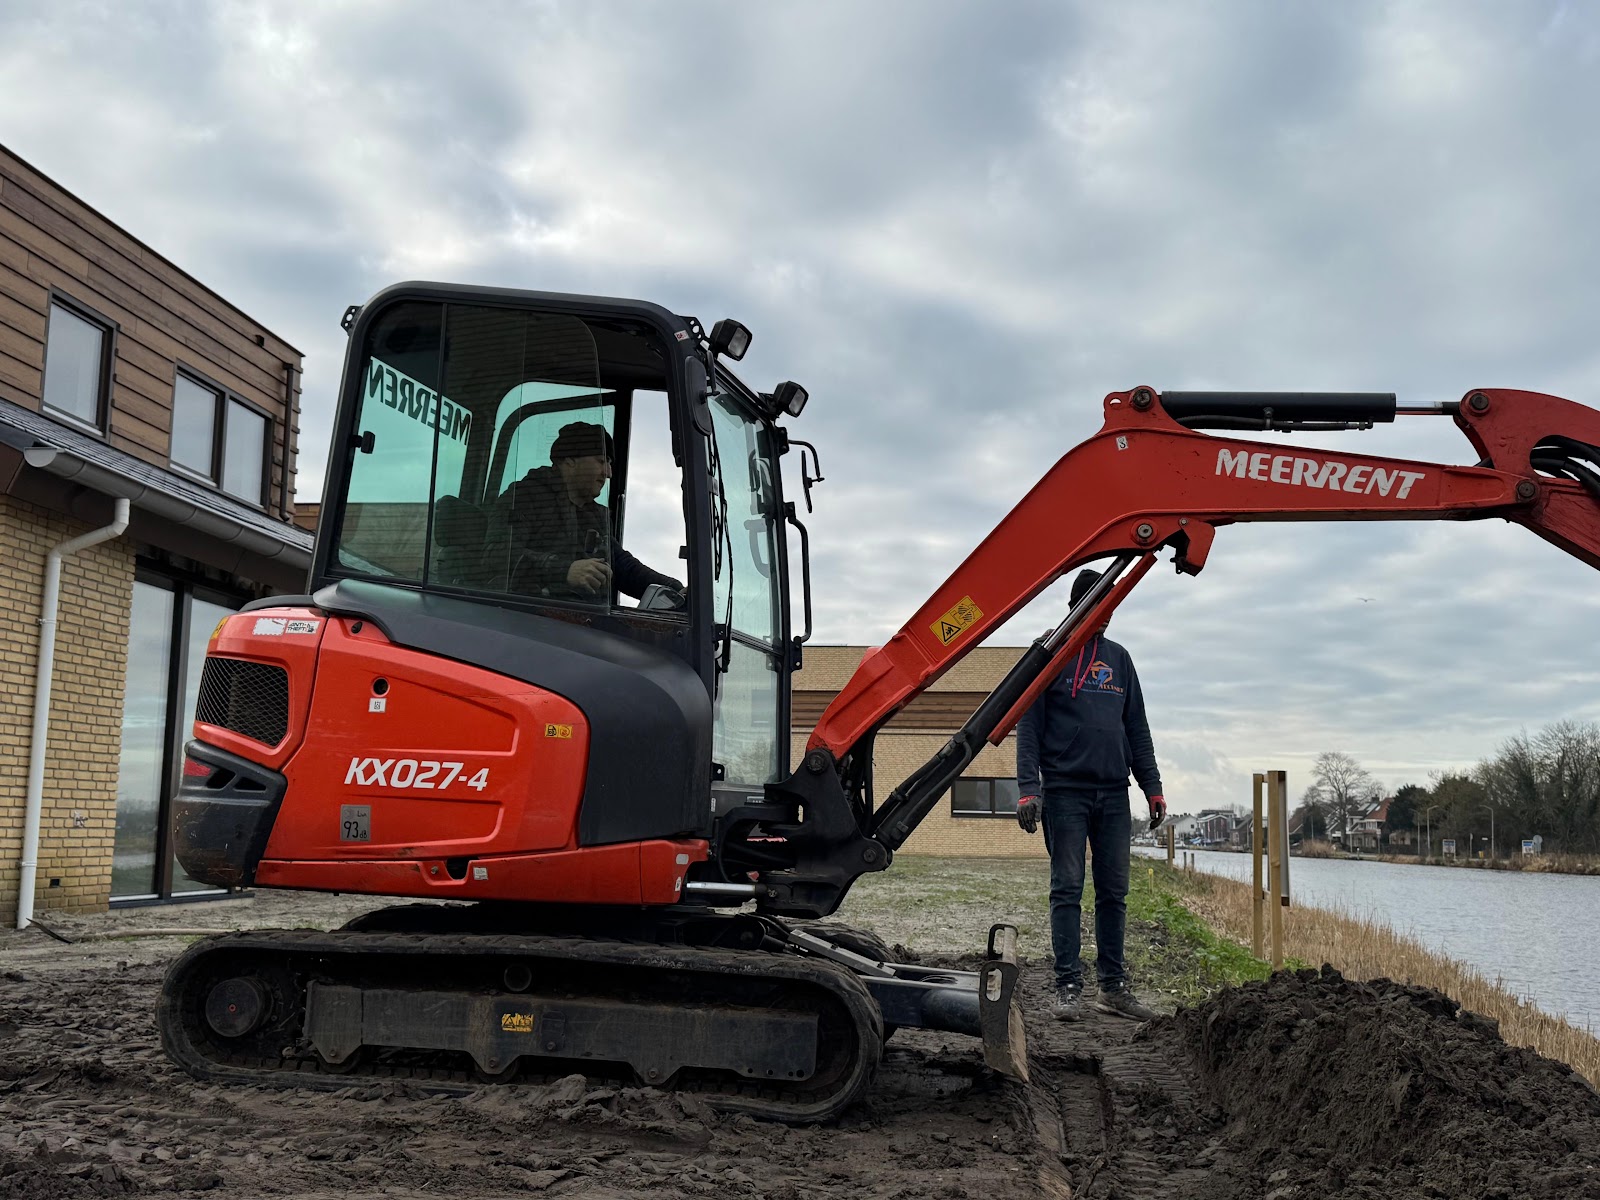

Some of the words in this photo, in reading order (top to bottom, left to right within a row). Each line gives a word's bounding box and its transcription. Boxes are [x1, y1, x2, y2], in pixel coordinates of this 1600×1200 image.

[1215, 448, 1425, 499] MEERRENT
[344, 757, 490, 791] KX027-4
[343, 820, 359, 839] 93
[359, 829, 368, 839] dB
